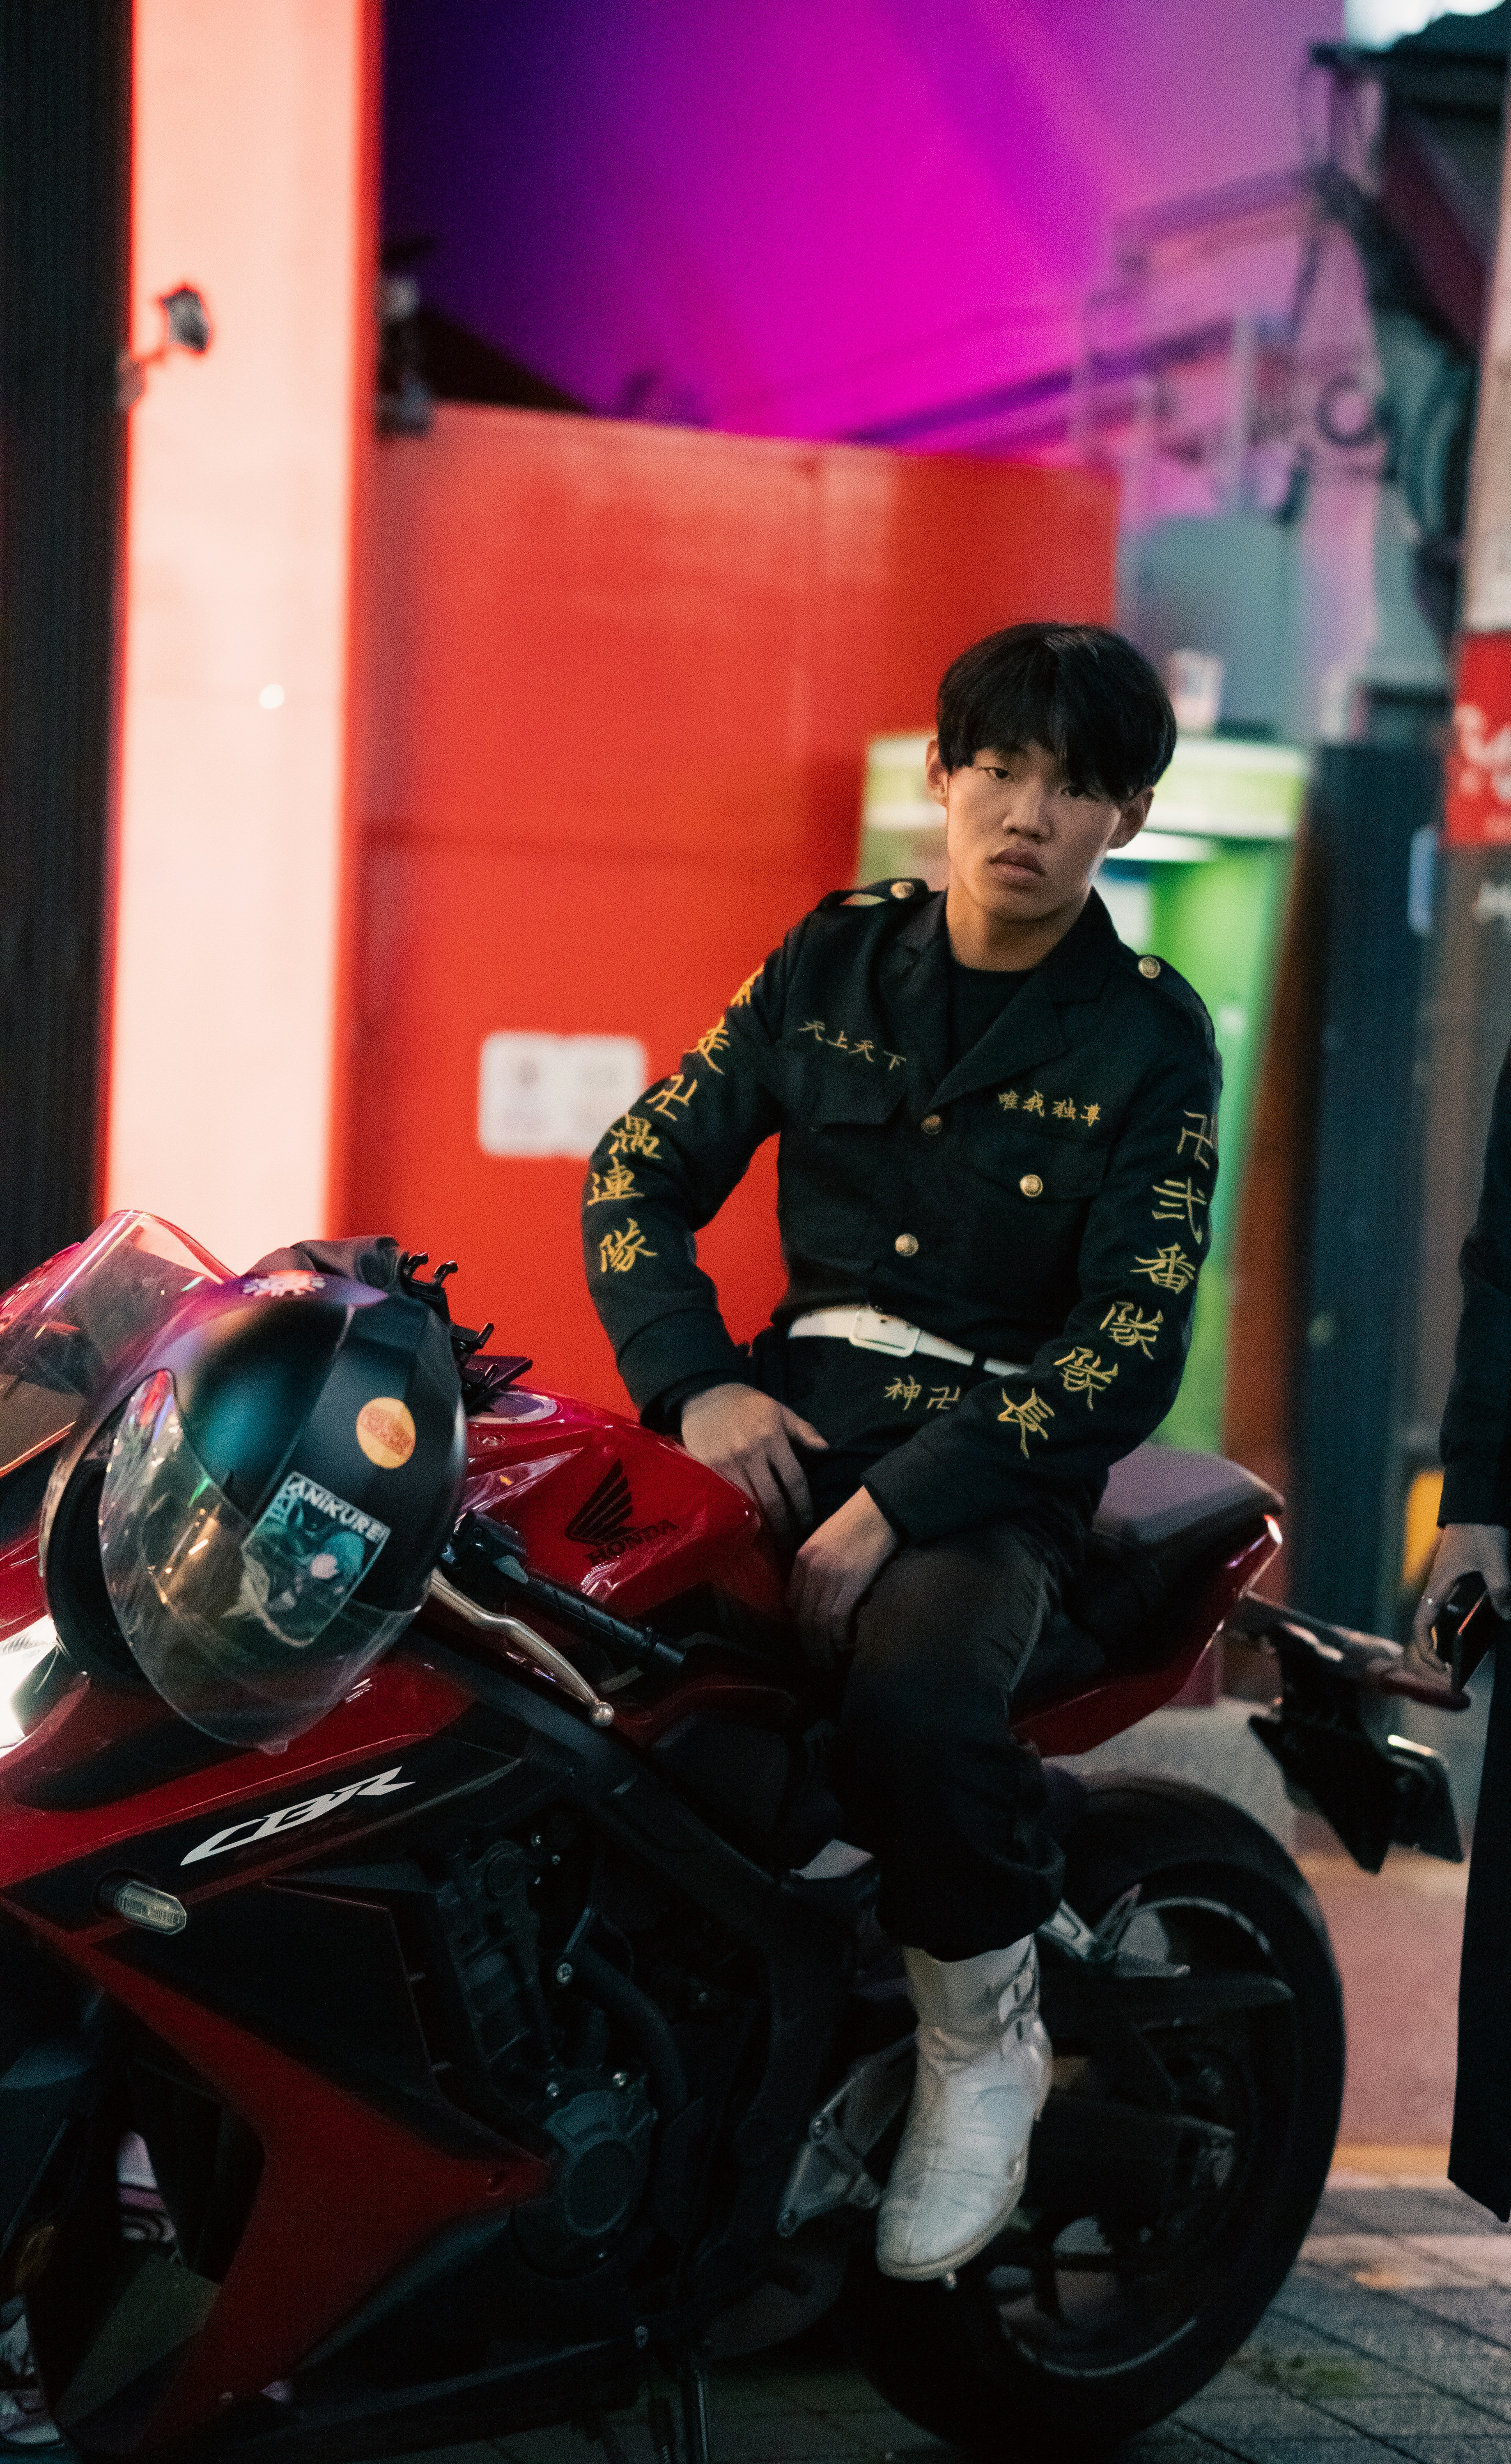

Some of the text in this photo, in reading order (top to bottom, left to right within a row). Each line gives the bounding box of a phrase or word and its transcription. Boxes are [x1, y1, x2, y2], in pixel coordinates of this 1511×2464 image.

[798, 1021, 907, 1070] 天上天下
[884, 1374, 961, 1411] 神卍
[584, 1519, 680, 1565] HONDA
[180, 1766, 416, 1866] CBR
